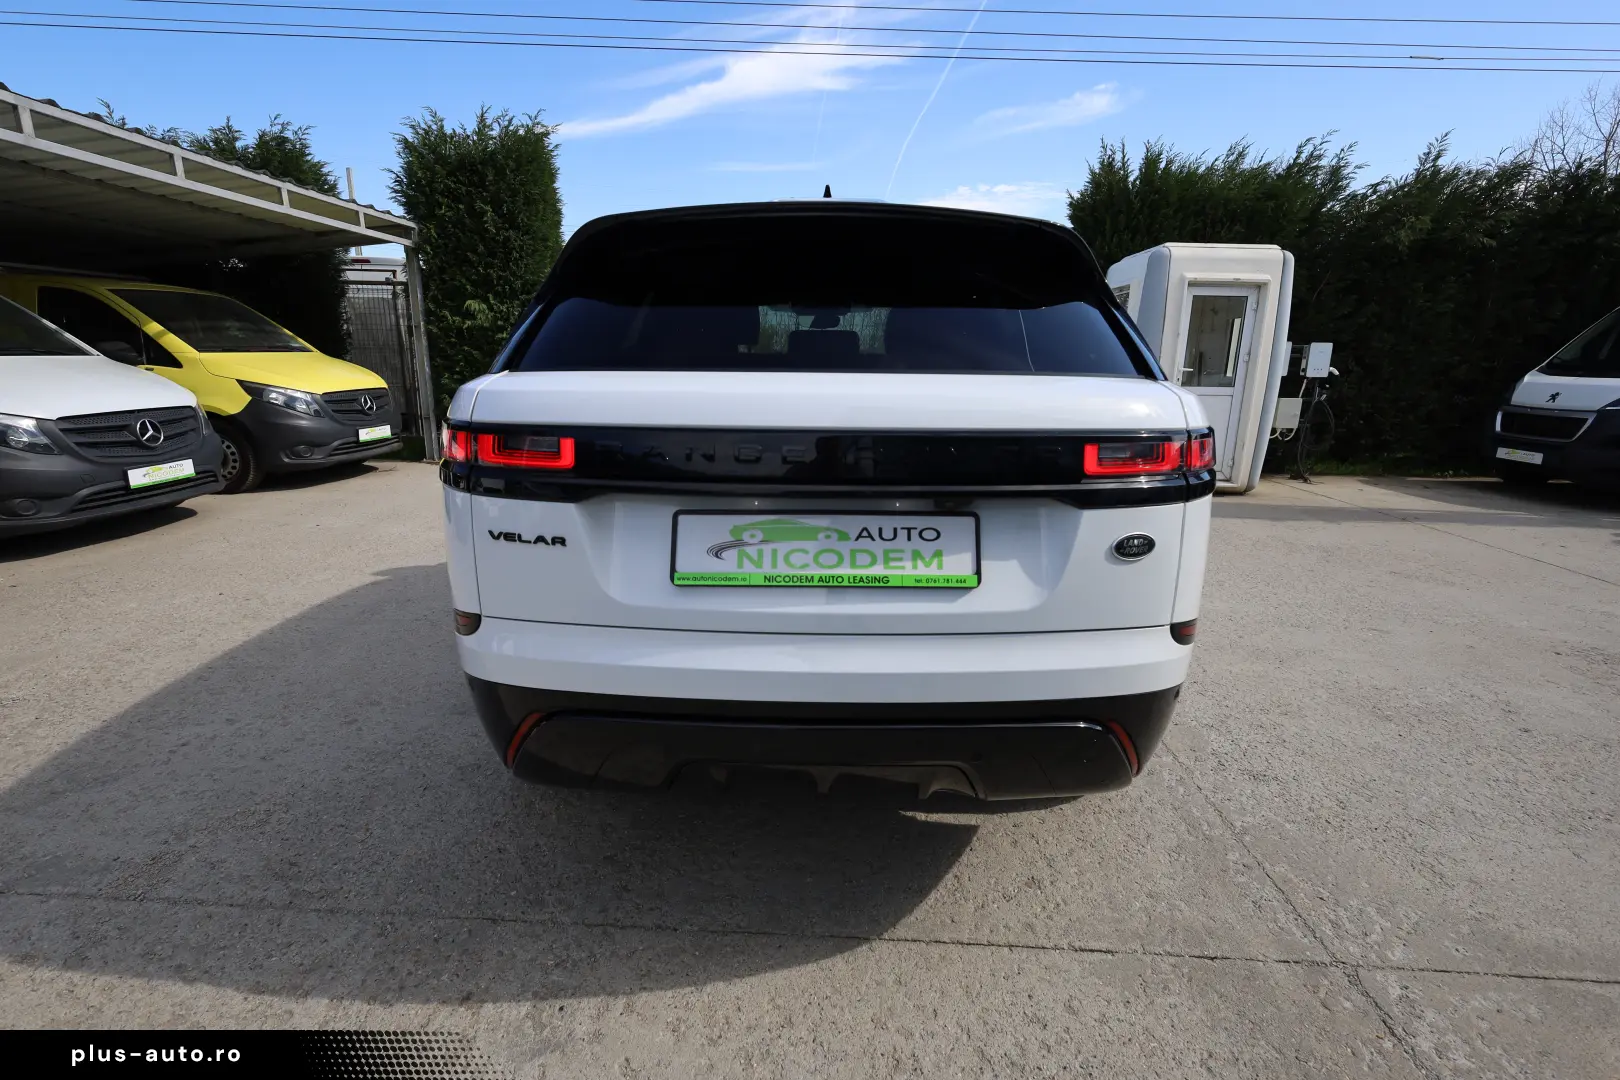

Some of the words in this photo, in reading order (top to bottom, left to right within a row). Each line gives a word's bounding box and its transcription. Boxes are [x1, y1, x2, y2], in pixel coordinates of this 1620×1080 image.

[147, 467, 185, 479] NICODEM
[488, 530, 567, 547] VELAR
[854, 527, 942, 542] AUTO
[1123, 539, 1144, 547] LAND
[1124, 546, 1149, 555] ROVER
[736, 548, 944, 571] NICODEM
[676, 575, 747, 583] www.autonicodem.ro
[763, 575, 814, 584] NICODEM
[817, 575, 844, 584] AUTO
[847, 576, 890, 585] LEASING
